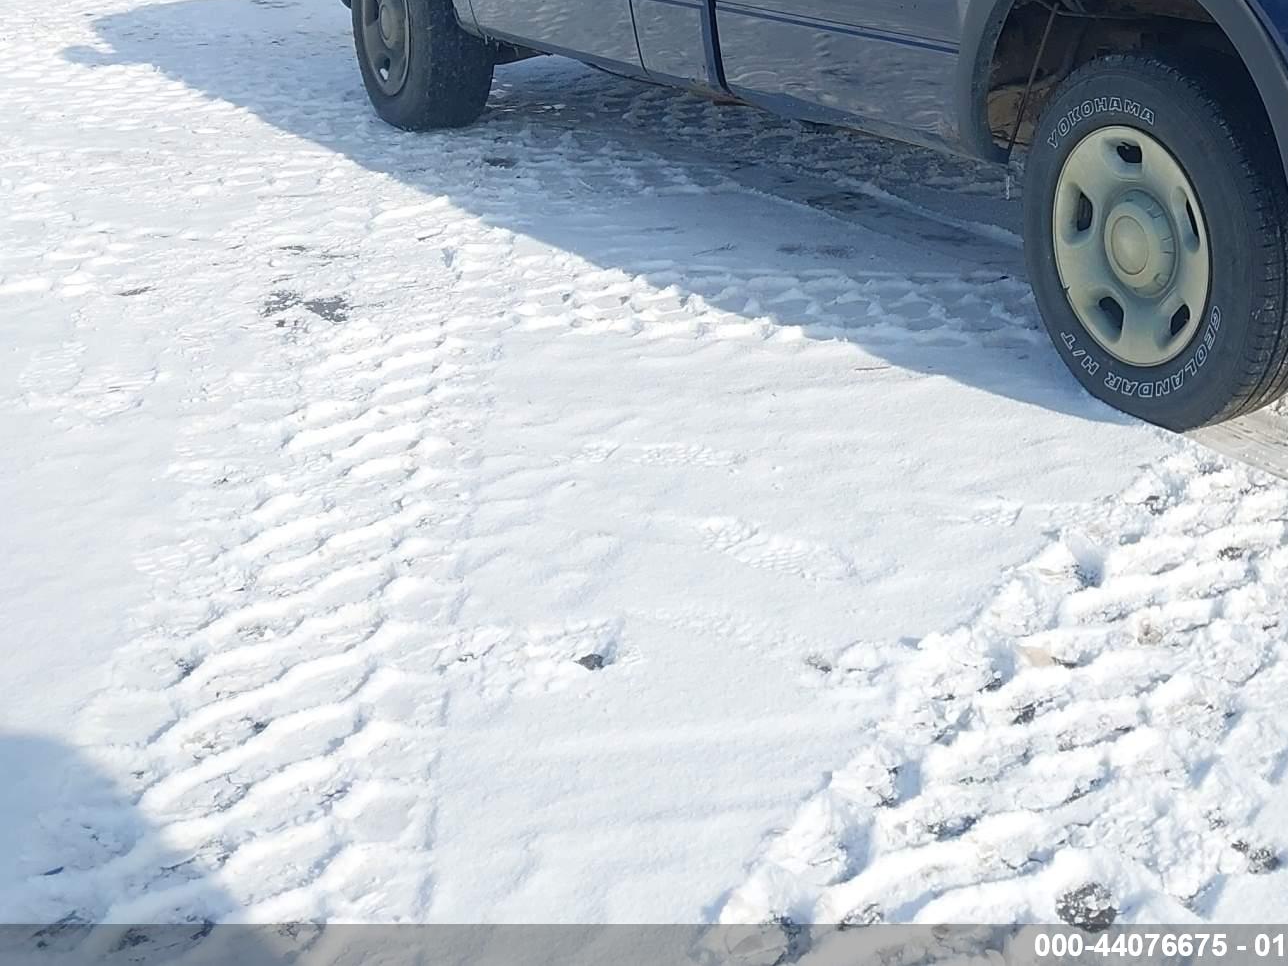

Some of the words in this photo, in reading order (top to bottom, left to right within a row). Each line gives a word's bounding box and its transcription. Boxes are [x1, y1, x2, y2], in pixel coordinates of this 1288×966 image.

[1047, 96, 1155, 148] YOKOHAMA
[1060, 331, 1101, 376] H/T
[1104, 305, 1222, 398] GEOLANDAR
